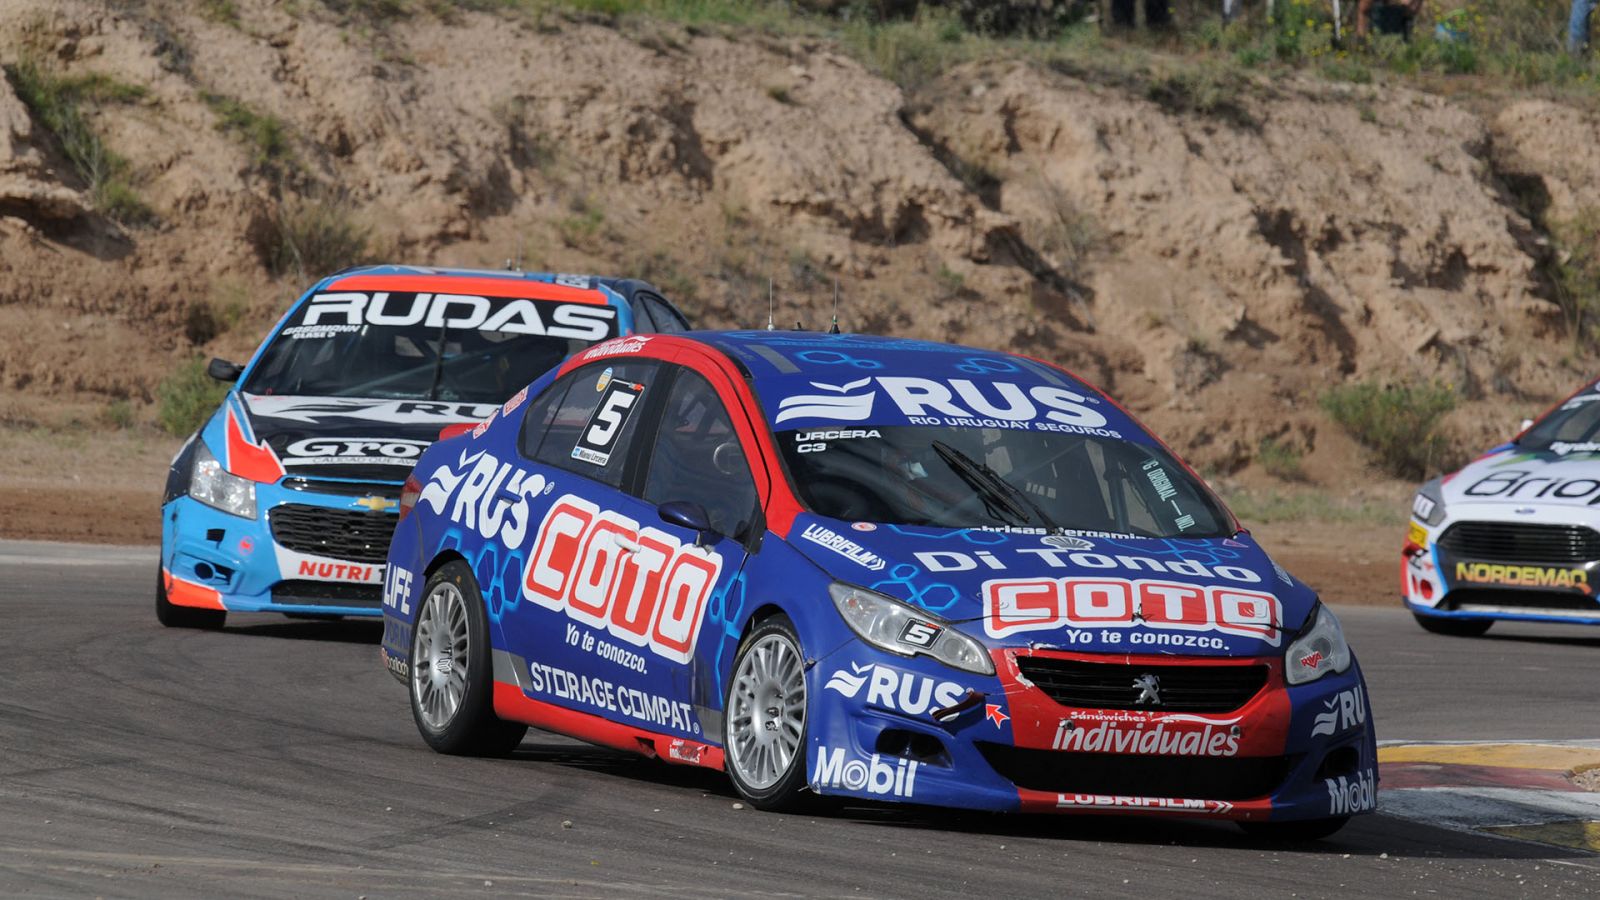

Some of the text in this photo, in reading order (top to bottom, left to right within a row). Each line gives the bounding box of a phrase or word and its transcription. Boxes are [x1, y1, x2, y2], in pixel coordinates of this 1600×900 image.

[302, 292, 616, 341] RUDAS
[586, 390, 637, 446] 5
[875, 376, 1108, 429] RUS
[286, 437, 429, 457] Gro
[795, 429, 882, 442] URCERA
[797, 442, 827, 454] C3
[908, 415, 1122, 440] RIO URUGUAY SEGUROS
[451, 453, 546, 550] RUS
[802, 524, 874, 563] LUBRIFILM
[299, 560, 373, 581] NUTRI
[525, 501, 719, 655] COTO
[913, 551, 1007, 572] Di
[1016, 548, 1262, 583] Tondo
[1456, 562, 1592, 595] NORDEMAQ
[383, 562, 413, 616] LIFE
[987, 579, 1279, 642] COTO
[566, 623, 648, 675] Yo te conozco.
[904, 623, 936, 646] 5
[1066, 629, 1230, 651] Yo te conozco.
[531, 661, 692, 733] STORAGE COMPAT
[866, 665, 966, 722] RUS
[1052, 721, 1241, 757] individuales
[813, 746, 919, 798] Mobil
[1325, 768, 1376, 815] Mobil
[1057, 794, 1206, 809] LUBRIFILM
